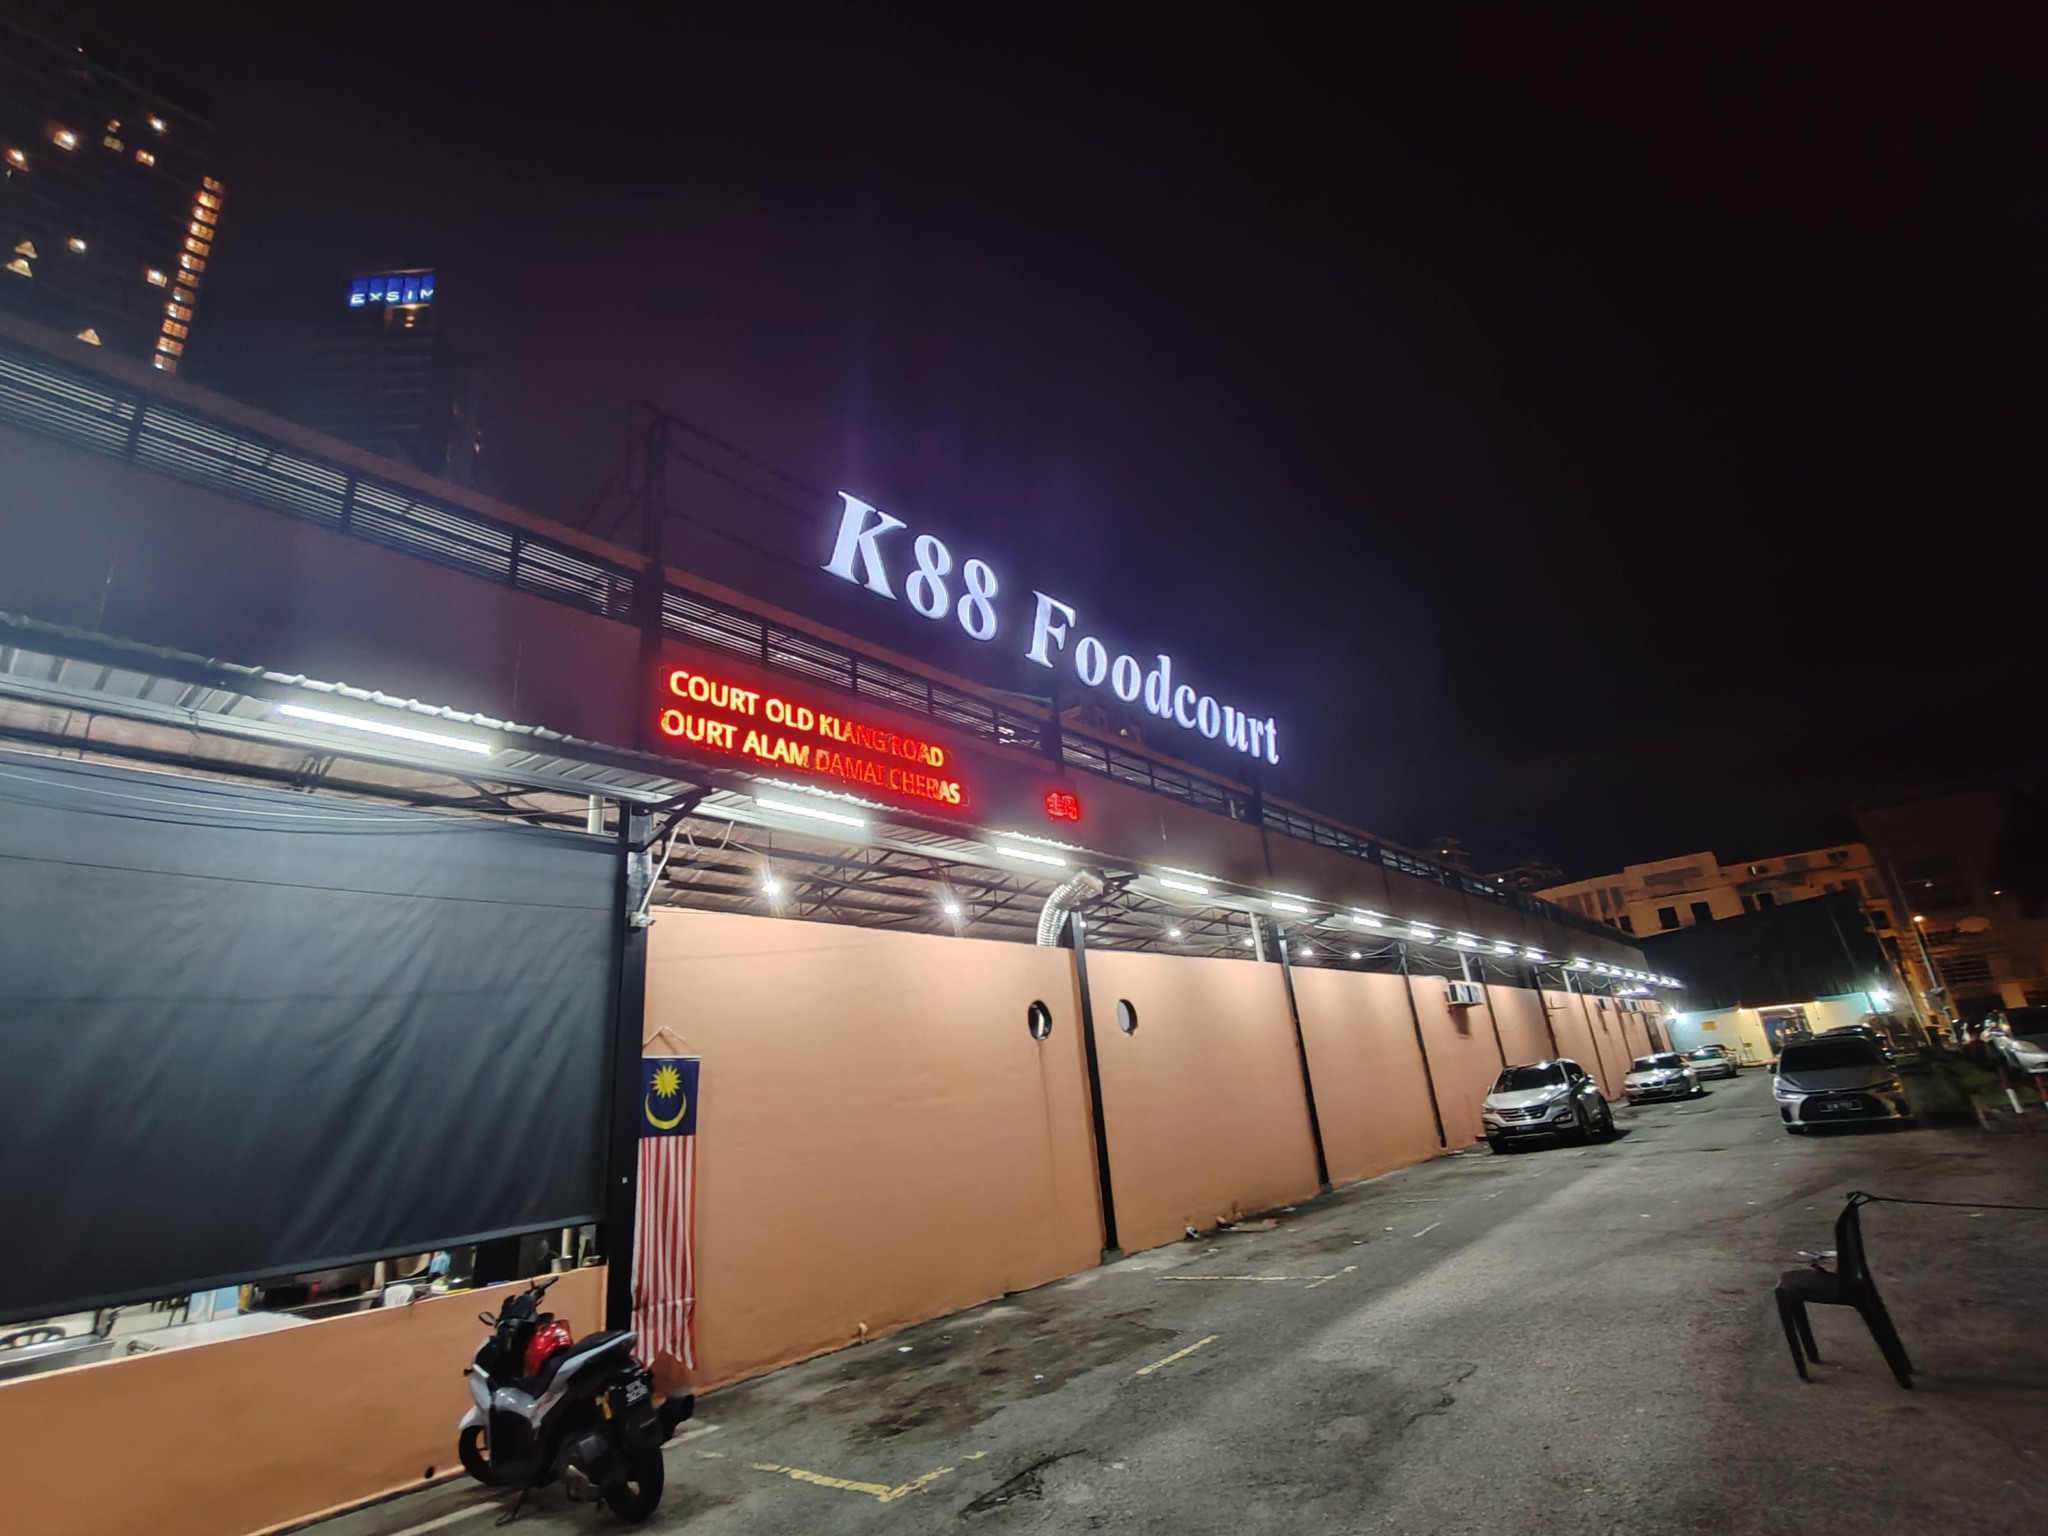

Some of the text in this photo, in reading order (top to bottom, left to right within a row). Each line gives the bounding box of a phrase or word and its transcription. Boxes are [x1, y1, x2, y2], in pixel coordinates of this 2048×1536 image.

[351, 289, 434, 304] EXSIM
[820, 491, 1280, 766] K88 Foodcourt
[670, 670, 944, 767] COURT OLD KLANG ROAD
[742, 730, 810, 768] ALAM
[815, 748, 884, 785] DAMAI
[889, 768, 961, 804] CHERAS
